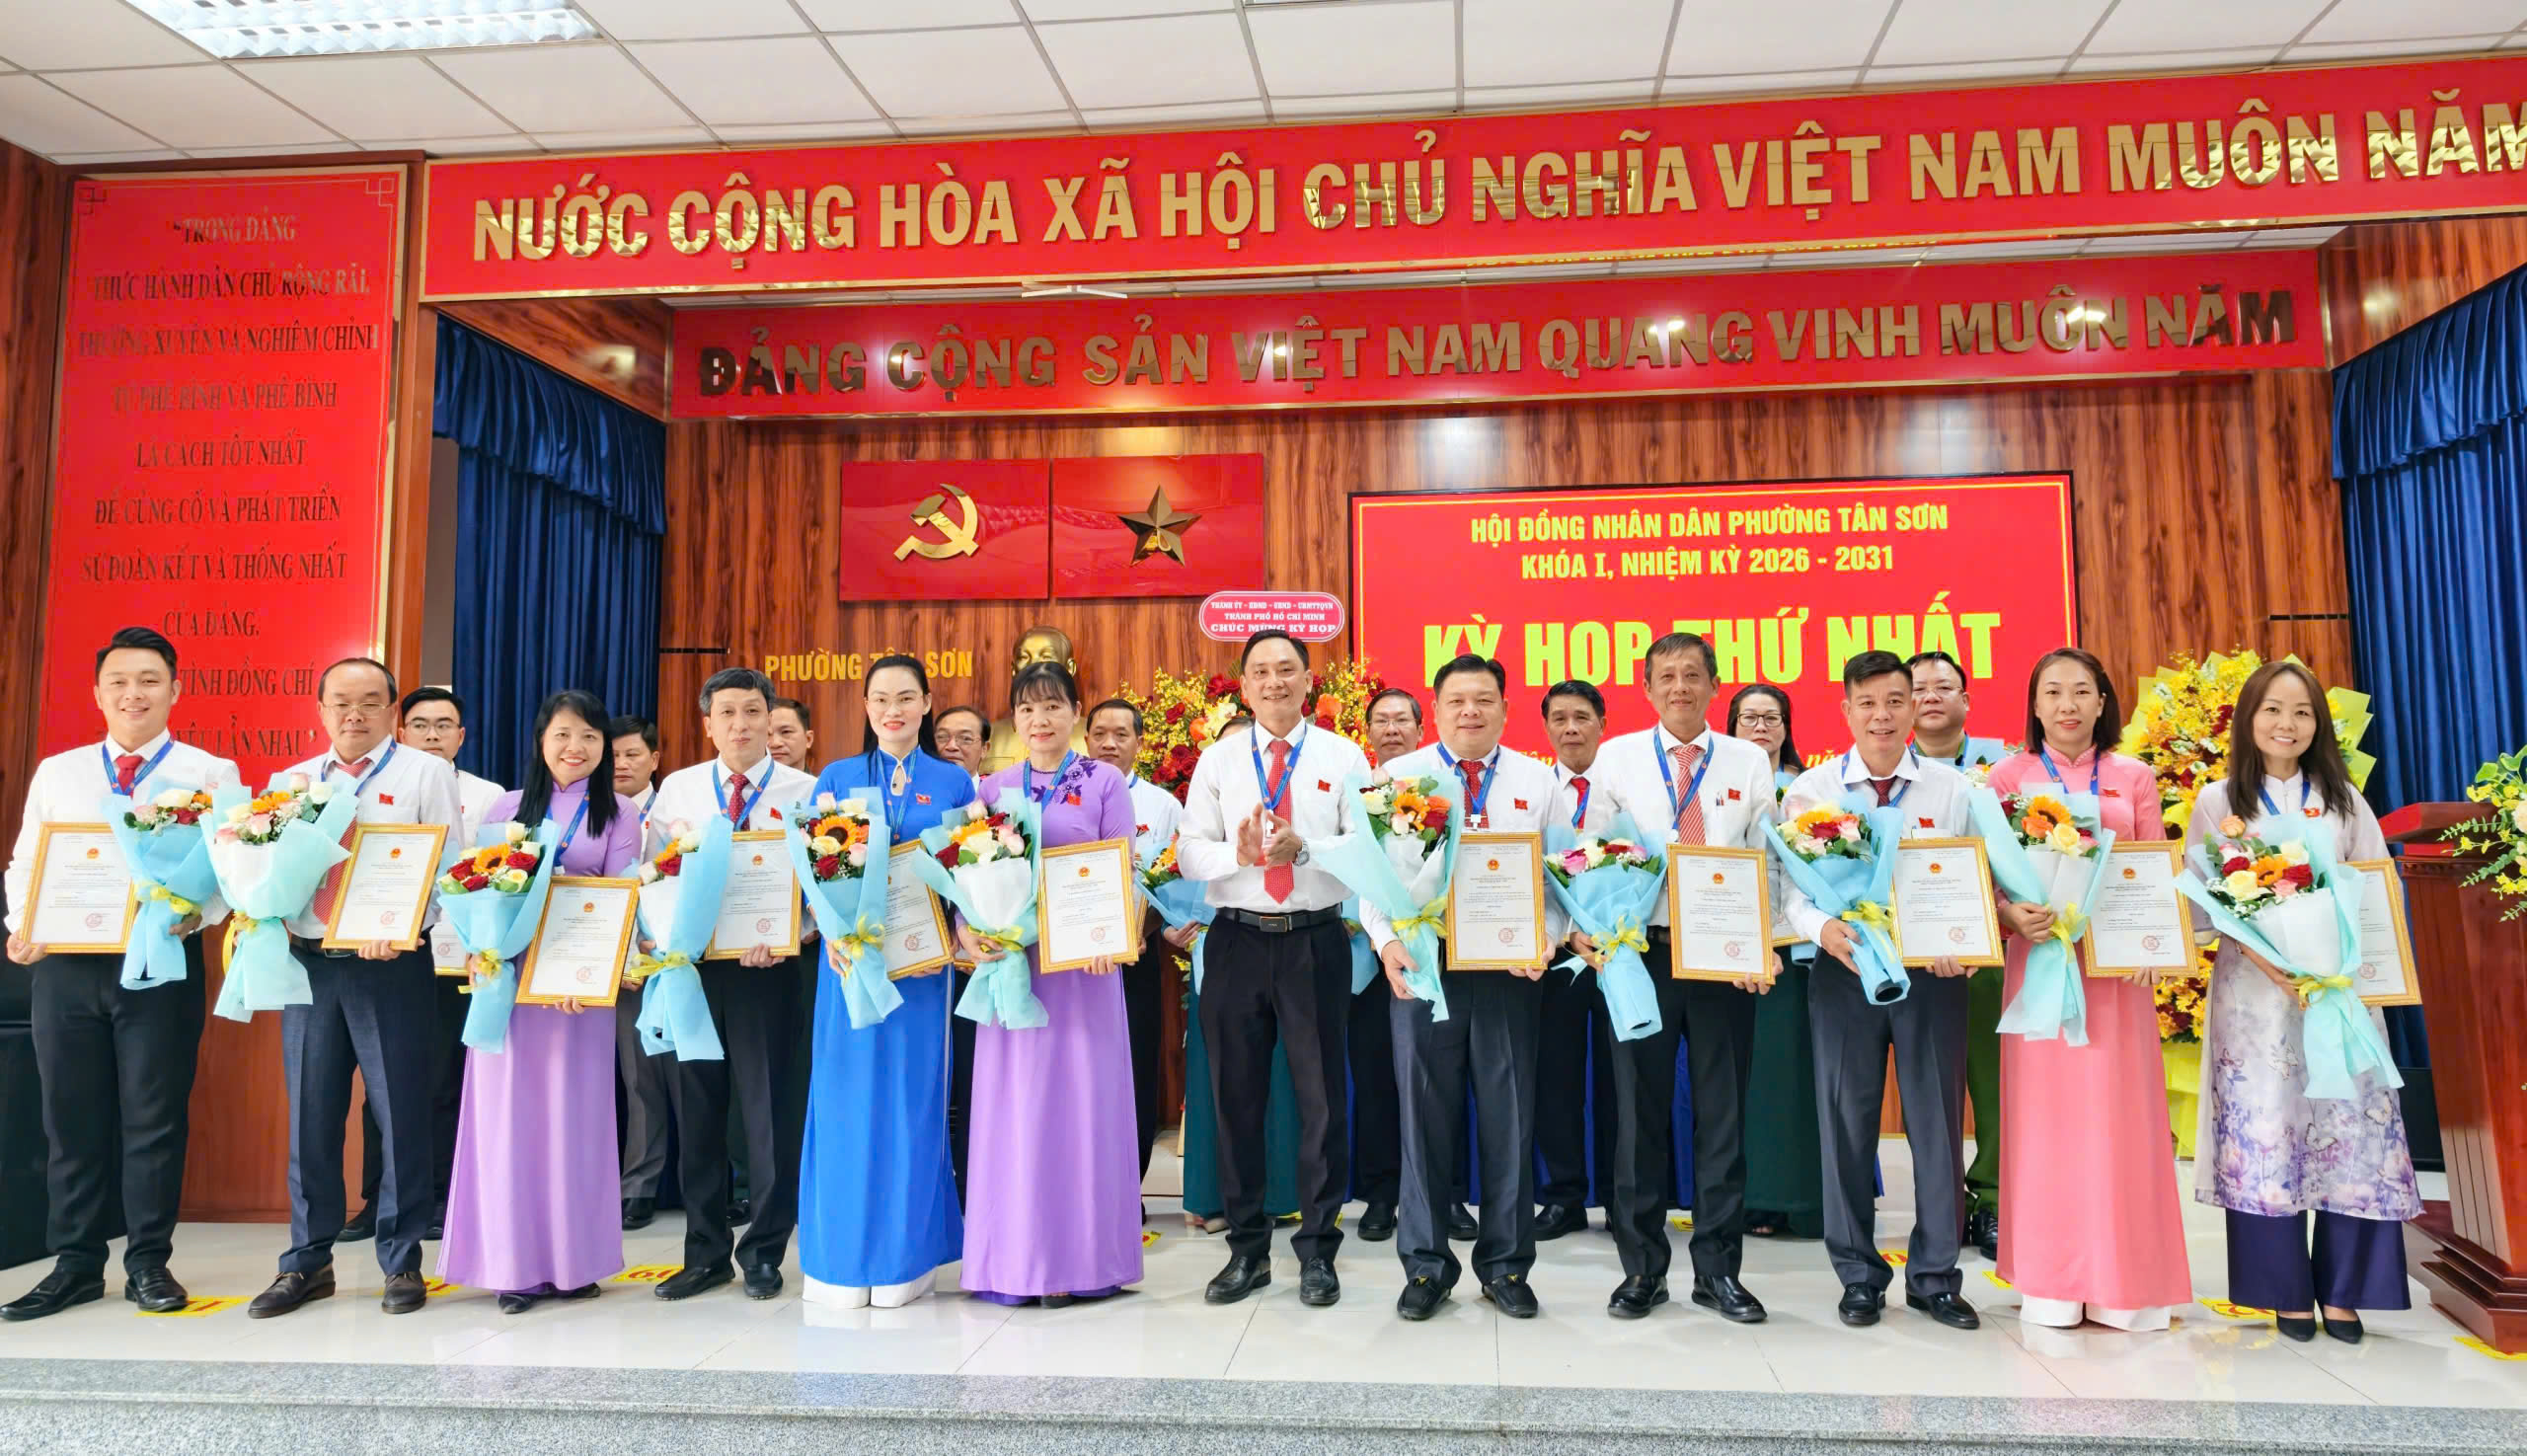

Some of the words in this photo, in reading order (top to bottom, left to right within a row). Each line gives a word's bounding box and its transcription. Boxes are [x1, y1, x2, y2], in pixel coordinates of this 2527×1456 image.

[474, 174, 650, 261] NƯỚC
[668, 172, 857, 269] CỘNG
[879, 162, 1021, 248] HÒA
[1042, 158, 1138, 243] XÃ
[1160, 152, 1275, 250] HỘI
[1303, 129, 1447, 231] CHỦ
[1472, 128, 1698, 222] NGHĨA
[1713, 119, 1881, 222] VIỆT
[1909, 125, 2081, 201] NAM
[2107, 98, 2339, 192] MUÔN
[2365, 88, 2527, 180] NĂM
[700, 327, 867, 396] ĐẢNG
[886, 323, 1056, 403] CỘNG
[1082, 314, 1209, 386] SẢN
[1233, 313, 1366, 392] VIỆT
[1386, 321, 1522, 377] NAM
[1539, 311, 1754, 378] QUANG
[1767, 304, 1921, 360] VINH
[1940, 284, 2129, 354] MUÔN
[2146, 283, 2295, 347] NĂM
[288, 482, 341, 522] TRIỂN
[1471, 512, 1511, 548] HỘI
[1518, 508, 1585, 542] ĐỒNG
[1592, 508, 1661, 540] NHÂN
[1669, 506, 1721, 537] DÂN
[1728, 502, 1831, 536] PHƯỜNG
[1837, 501, 1887, 532] TÂN
[1894, 501, 1949, 531] SƠN
[233, 542, 294, 579] THỐNG
[298, 541, 347, 579] NHẤT
[1521, 548, 1587, 579] KHÓA
[1621, 546, 1702, 581] NHIỆM
[1710, 544, 1741, 575] KỲ
[1749, 548, 1810, 573] 2026
[1835, 545, 1893, 571] 2031
[1210, 622, 1244, 632] CHÚC
[1423, 613, 1503, 688] KỲ
[1826, 590, 2001, 682] NHẤT
[226, 654, 276, 696] ĐỒNG
[281, 660, 315, 696] CHÍ
[765, 647, 862, 681] PHƯỜNG
[925, 648, 972, 679] SƠN
